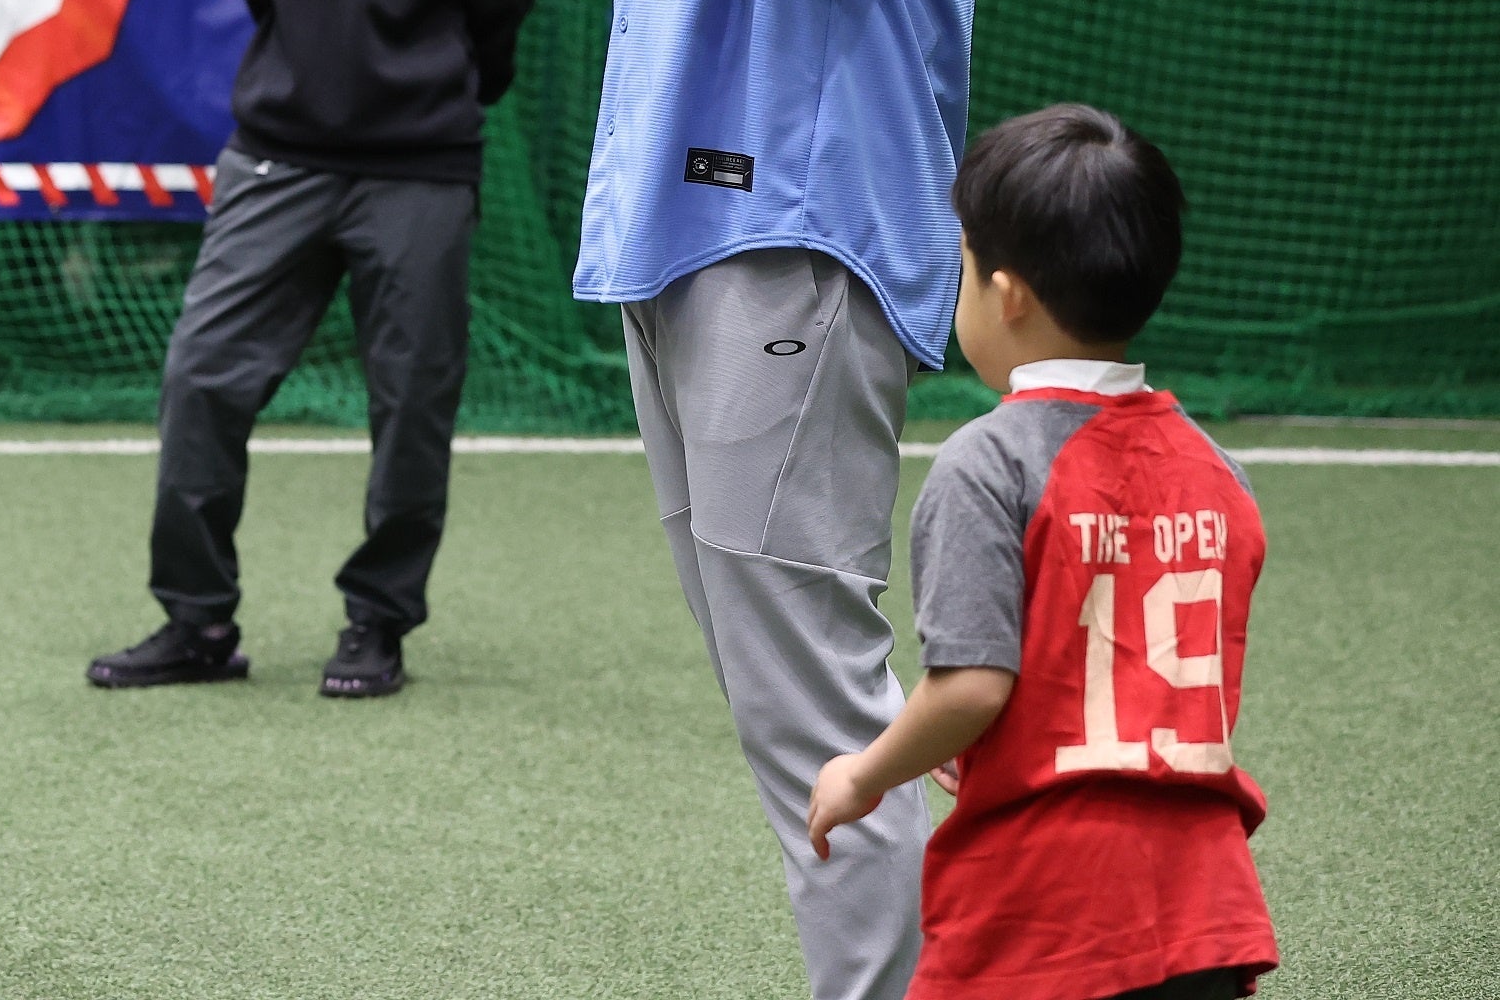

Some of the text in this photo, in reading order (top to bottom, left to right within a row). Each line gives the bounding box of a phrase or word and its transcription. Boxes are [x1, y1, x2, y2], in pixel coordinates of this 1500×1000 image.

[1068, 509, 1229, 565] THE OPEN
[1054, 568, 1234, 775] 19
